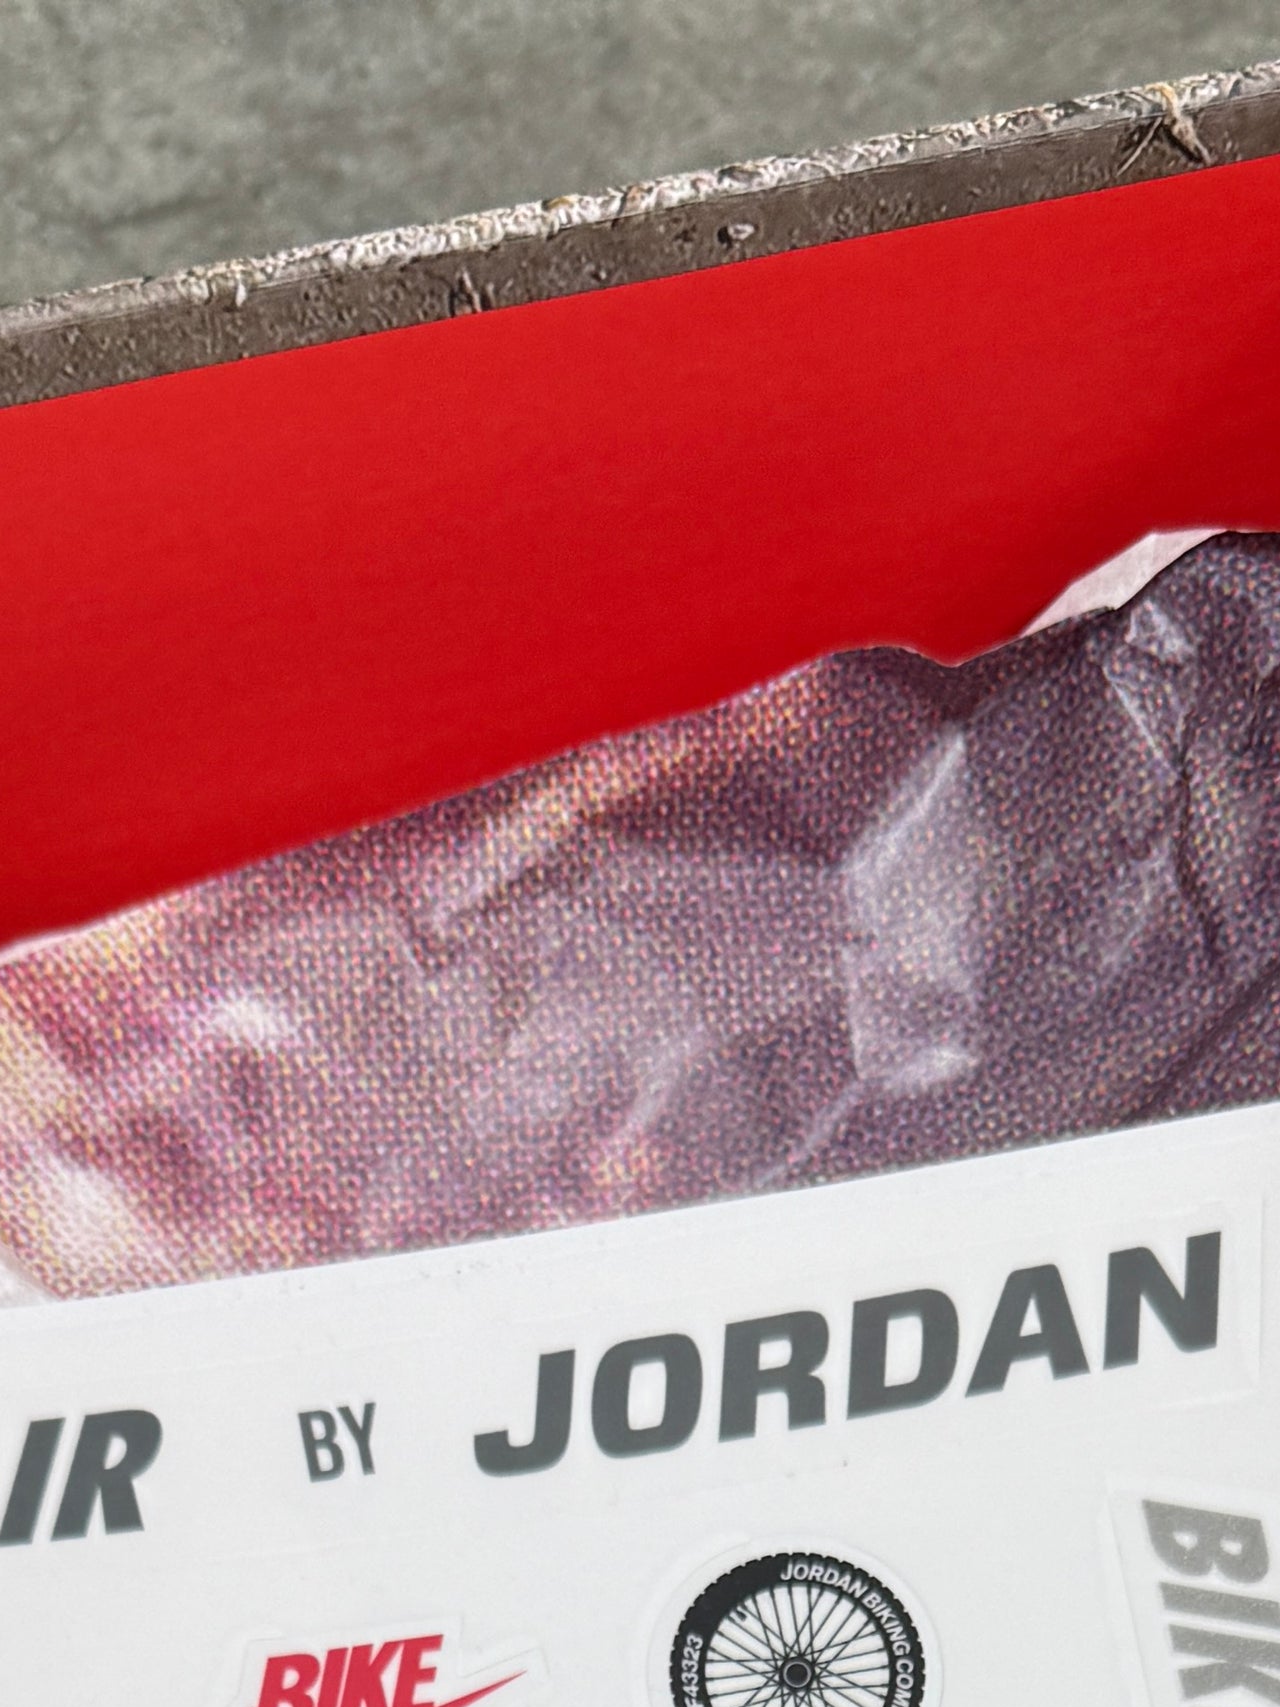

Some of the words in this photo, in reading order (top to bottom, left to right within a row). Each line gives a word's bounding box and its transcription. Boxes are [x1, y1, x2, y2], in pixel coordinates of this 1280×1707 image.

[298, 1402, 377, 1483] BY
[474, 1232, 1222, 1477] JORDAN
[780, 1563, 869, 1598] JORDAN
[862, 1593, 911, 1656] BIKING
